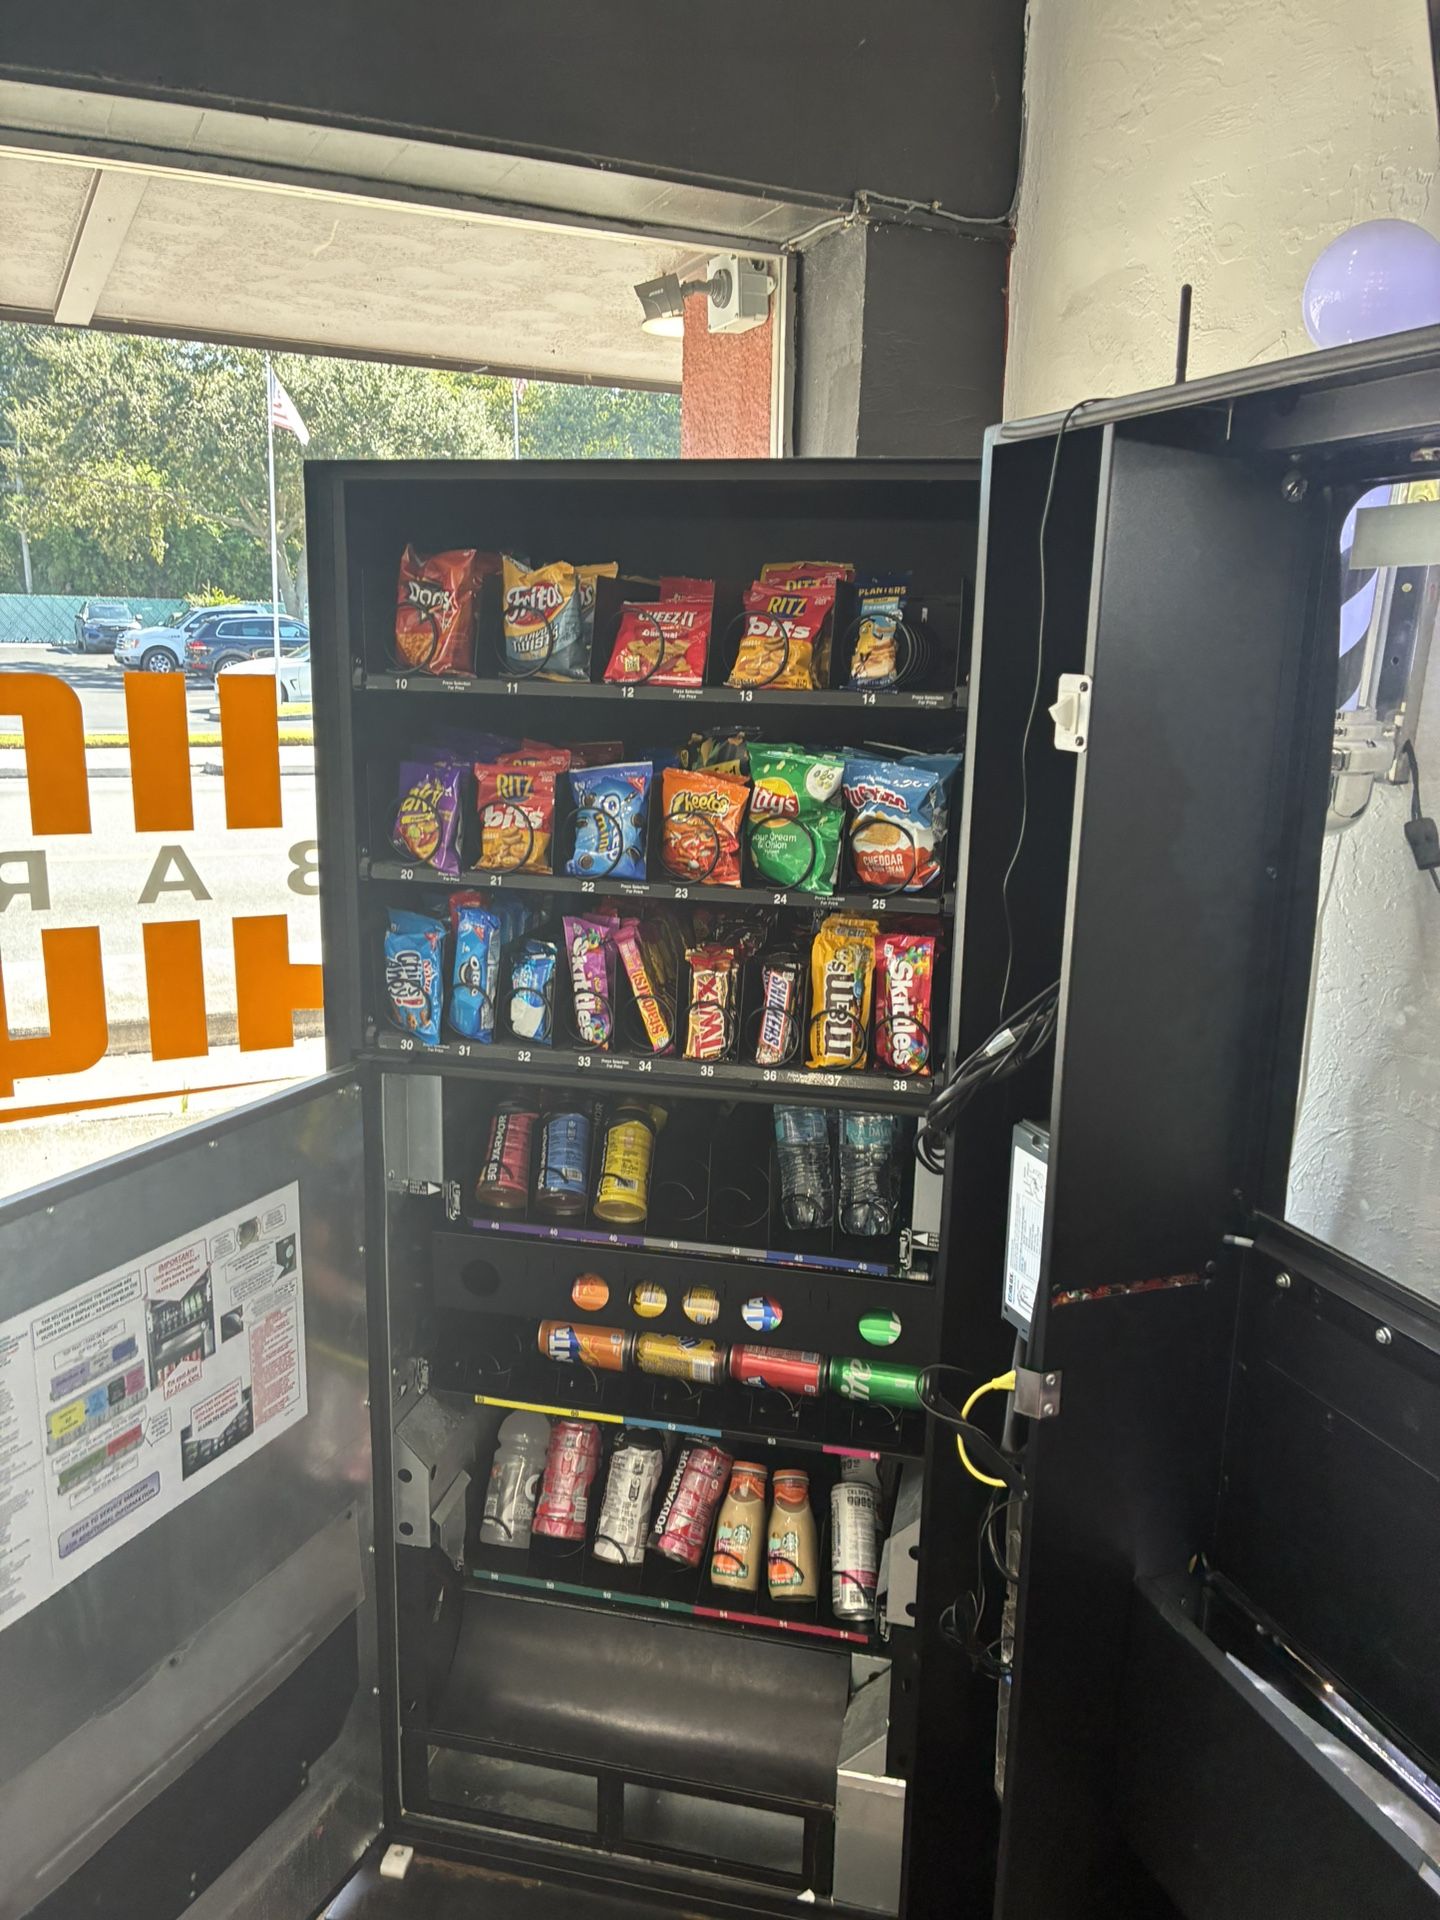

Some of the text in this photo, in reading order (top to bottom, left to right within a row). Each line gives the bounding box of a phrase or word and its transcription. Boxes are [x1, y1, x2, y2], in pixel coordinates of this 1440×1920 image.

[859, 586, 907, 597] PLANTERS
[505, 584, 563, 622] Fritos
[767, 596, 808, 617] RITZ
[748, 616, 811, 639] bits
[641, 629, 679, 639] Oriinal
[395, 679, 407, 689] 10
[506, 682, 518, 693] 11
[621, 687, 634, 698] 12
[739, 690, 753, 702] 13
[862, 694, 876, 705] 14
[496, 773, 534, 799] RITZ
[670, 790, 731, 822] Cheetos
[751, 786, 798, 816] Lay's
[484, 804, 544, 829] bits
[770, 833, 797, 842] Cream
[765, 841, 787, 849] Onion
[863, 852, 904, 866] CHEDDAR
[400, 869, 413, 880] 20
[490, 875, 502, 886] 21
[581, 882, 595, 893] 22
[675, 888, 688, 898] 23
[774, 894, 787, 904] 24
[872, 899, 886, 909] 25
[572, 938, 596, 1041] Skittles
[694, 976, 726, 1058] TWIX
[888, 960, 918, 1065] Skittles
[400, 1040, 413, 1050] 30
[458, 1045, 471, 1056] 31
[518, 1050, 531, 1061] 32
[578, 1056, 591, 1067] 33
[638, 1061, 652, 1072] 34
[700, 1066, 713, 1077] 35
[763, 1070, 777, 1081] 36
[827, 1075, 842, 1086] 37
[893, 1080, 907, 1091] 38
[550, 1228, 559, 1237] 40
[609, 1234, 619, 1243] 40
[549, 1326, 574, 1364] NTA
[654, 1450, 690, 1535] BODYARMOR
